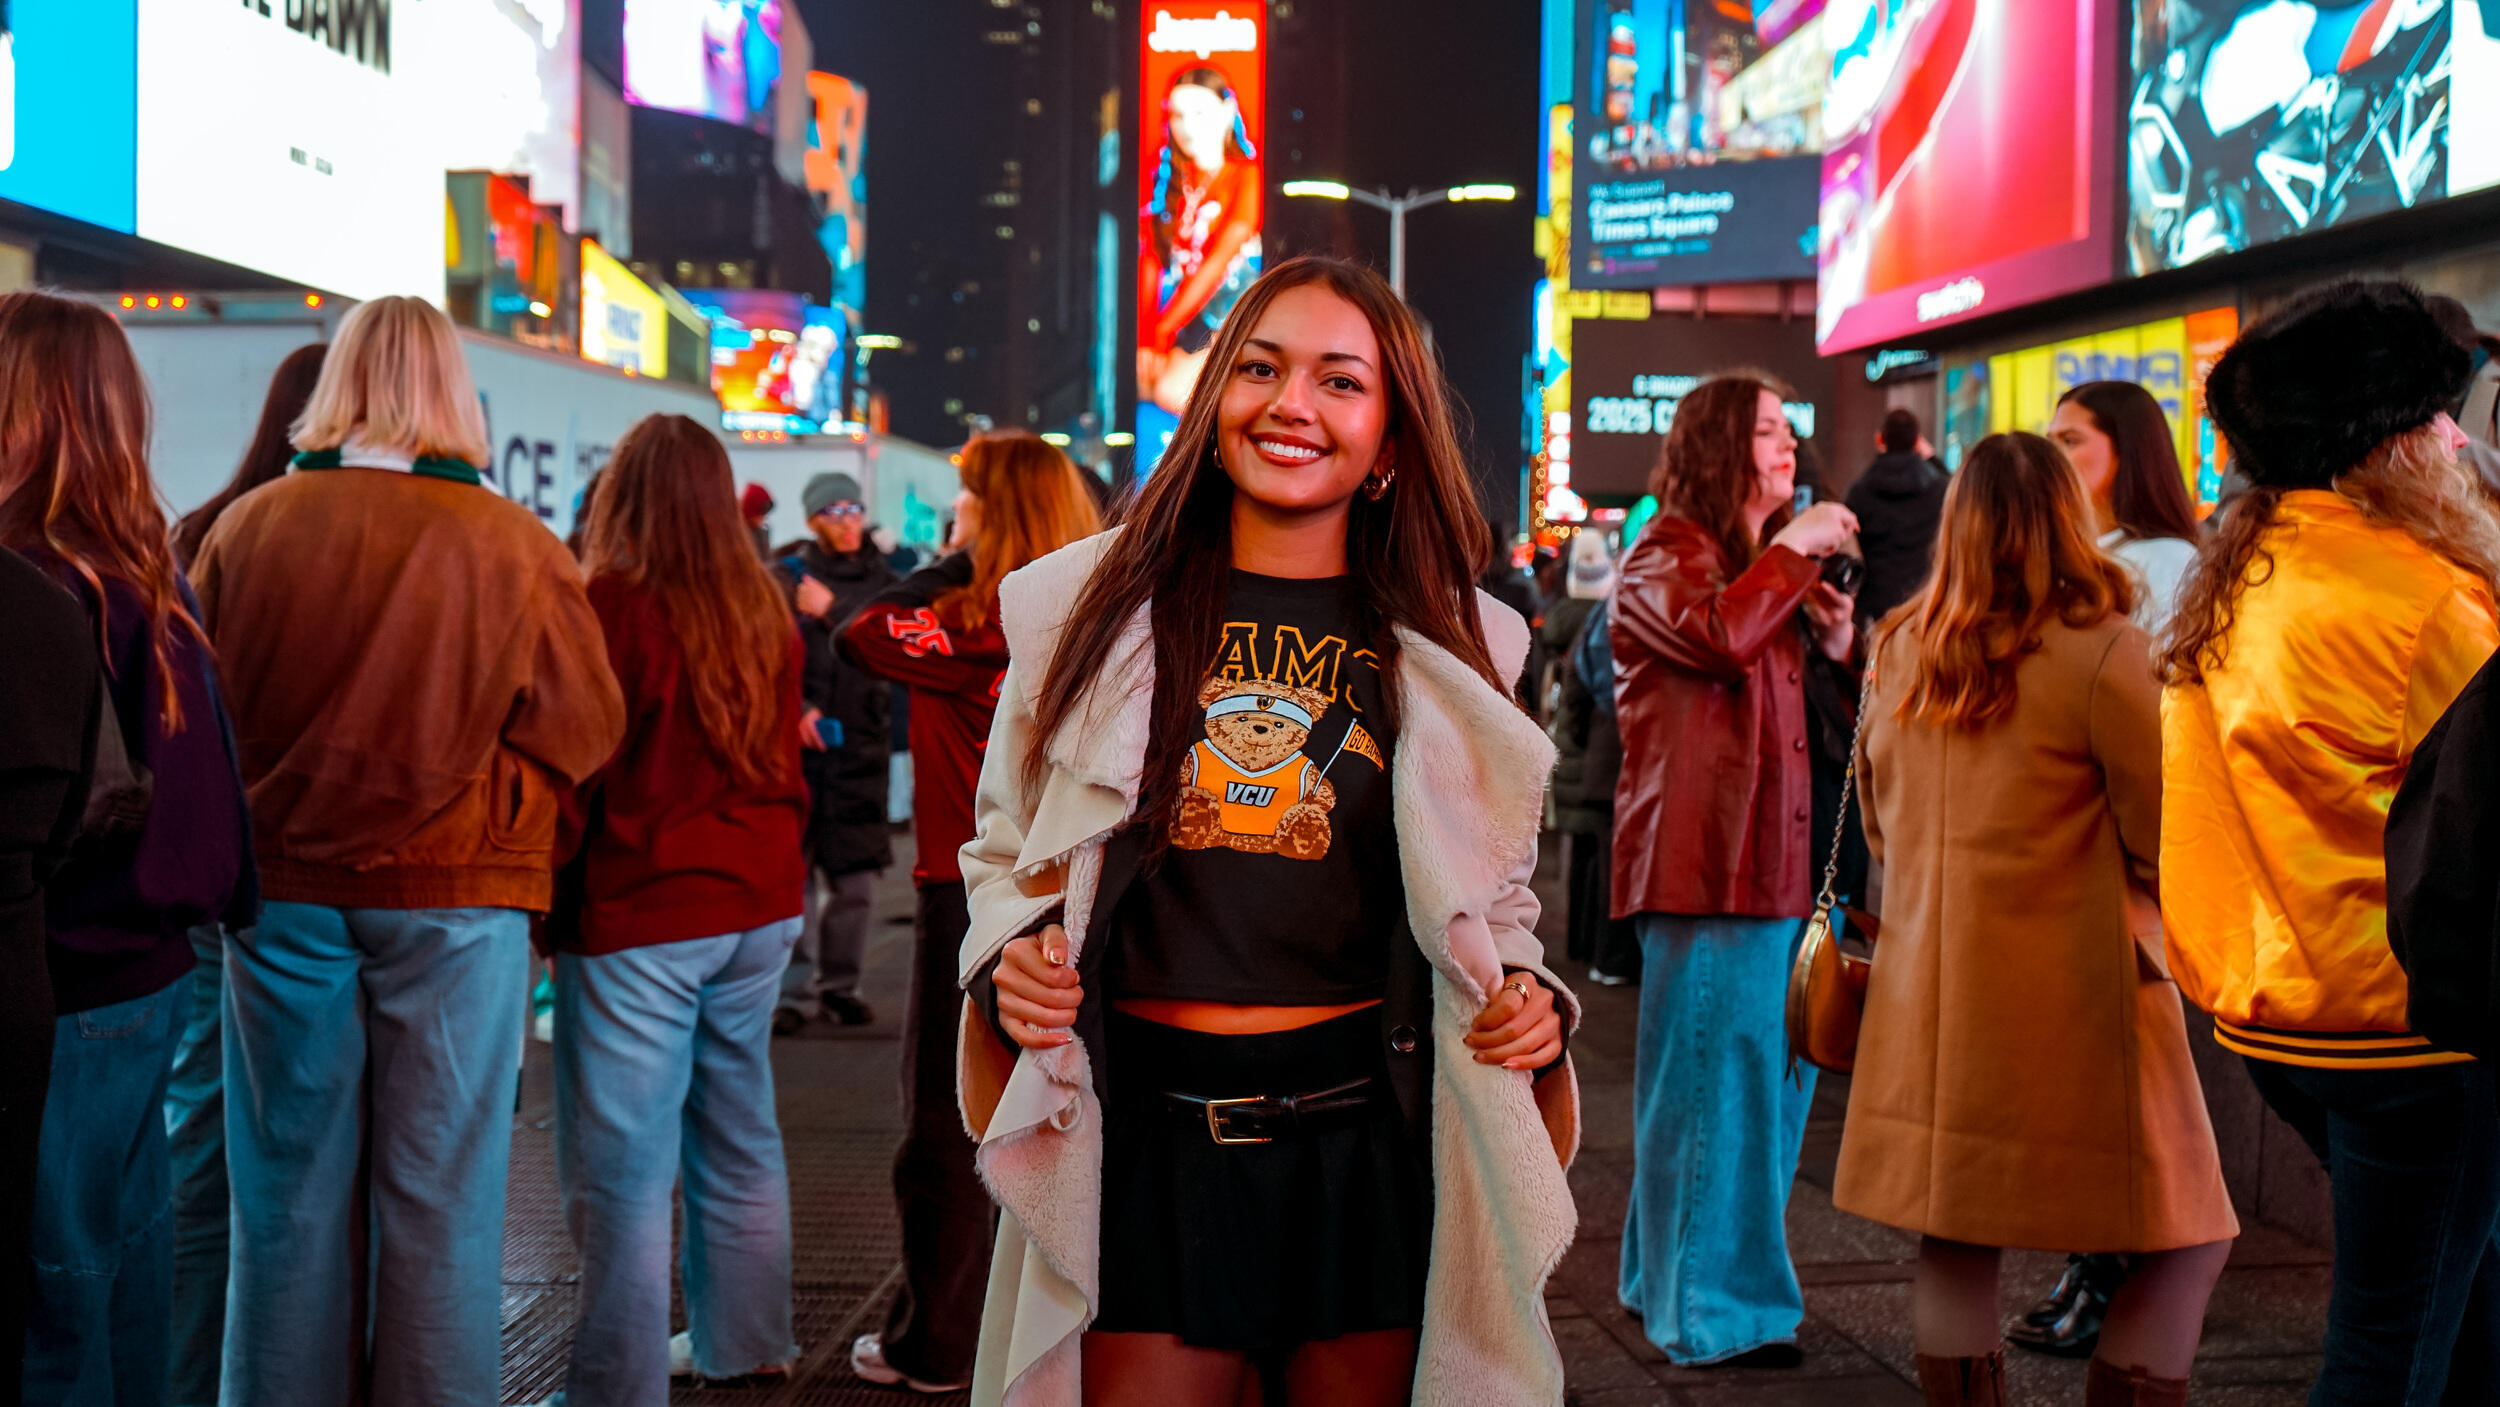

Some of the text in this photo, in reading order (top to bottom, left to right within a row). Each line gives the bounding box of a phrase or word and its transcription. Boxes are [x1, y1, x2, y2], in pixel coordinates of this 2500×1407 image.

[1591, 214, 1719, 242] Times Square
[1588, 397, 1652, 433] 2025
[886, 607, 953, 658] 25
[1349, 729, 1367, 751] GO
[1225, 781, 1279, 808] VCU
